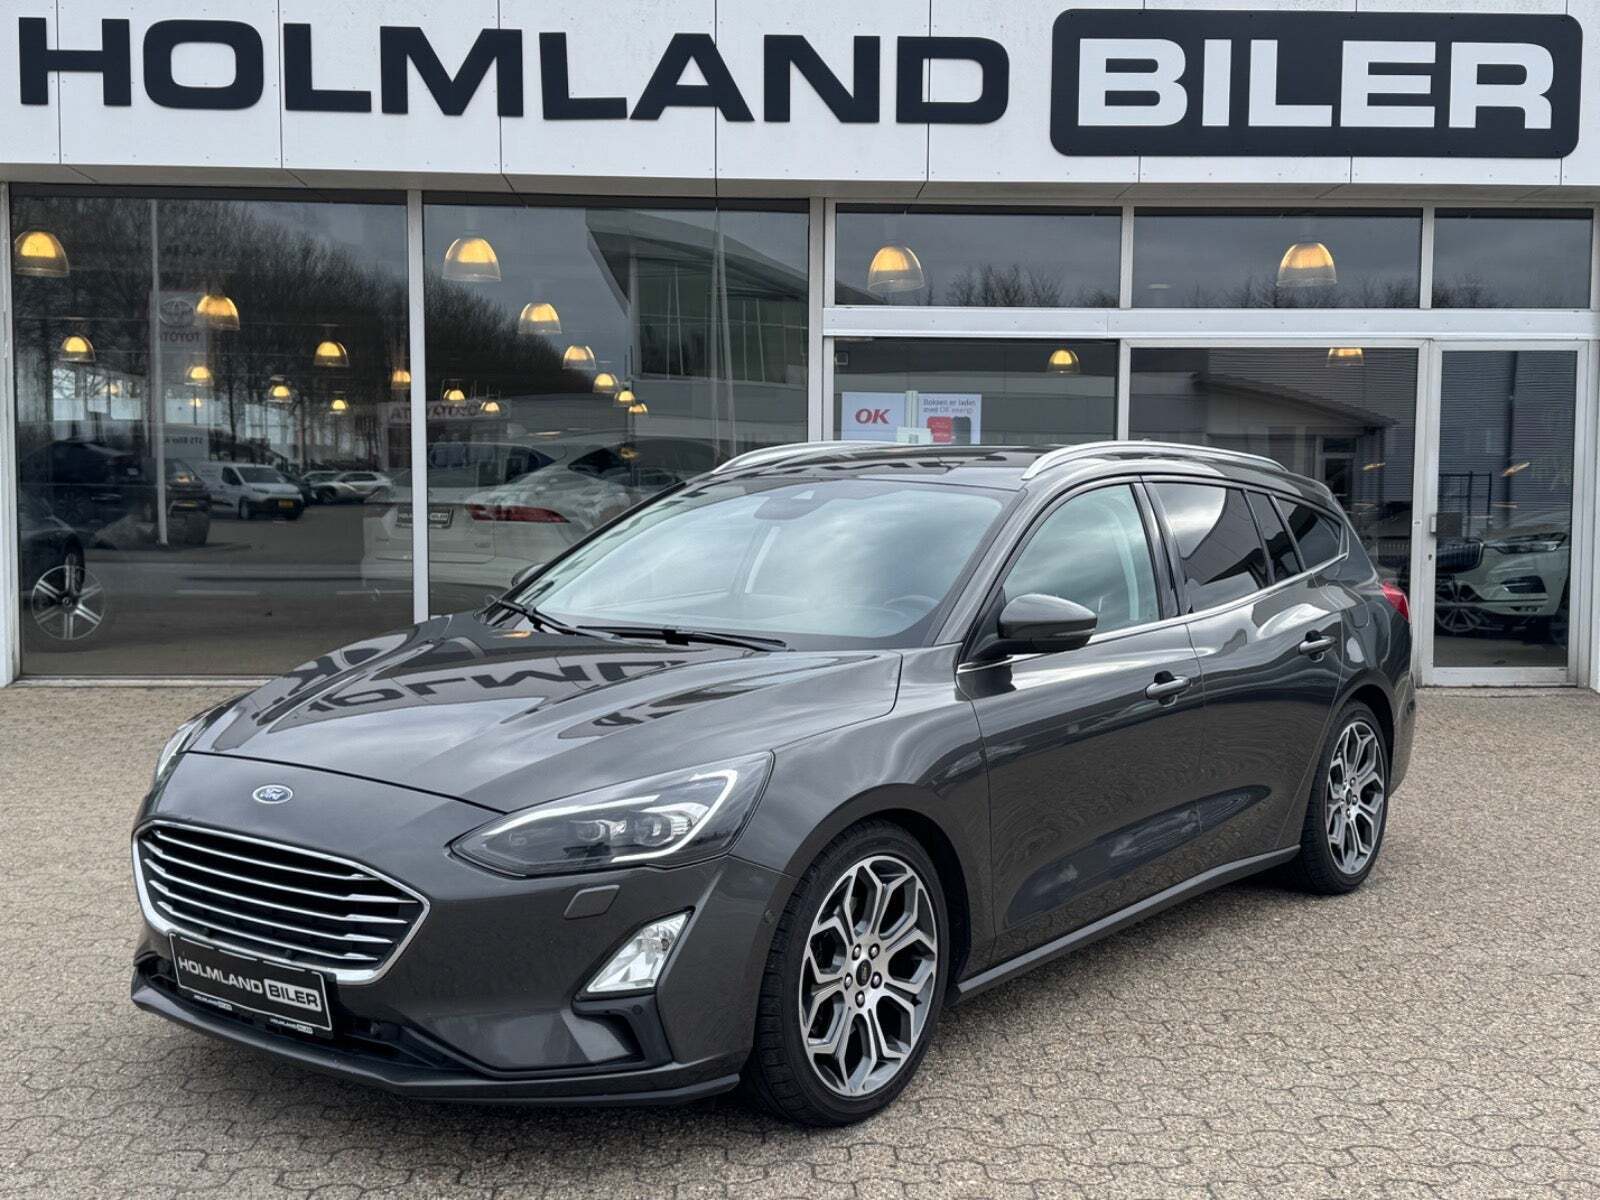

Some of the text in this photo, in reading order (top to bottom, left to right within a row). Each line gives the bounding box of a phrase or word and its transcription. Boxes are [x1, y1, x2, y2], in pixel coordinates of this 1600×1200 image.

[19, 18, 1554, 130] HOLMLAND BILER
[855, 408, 891, 424] OK
[177, 956, 263, 994] HOLMLAND
[268, 983, 318, 1008] BILER
